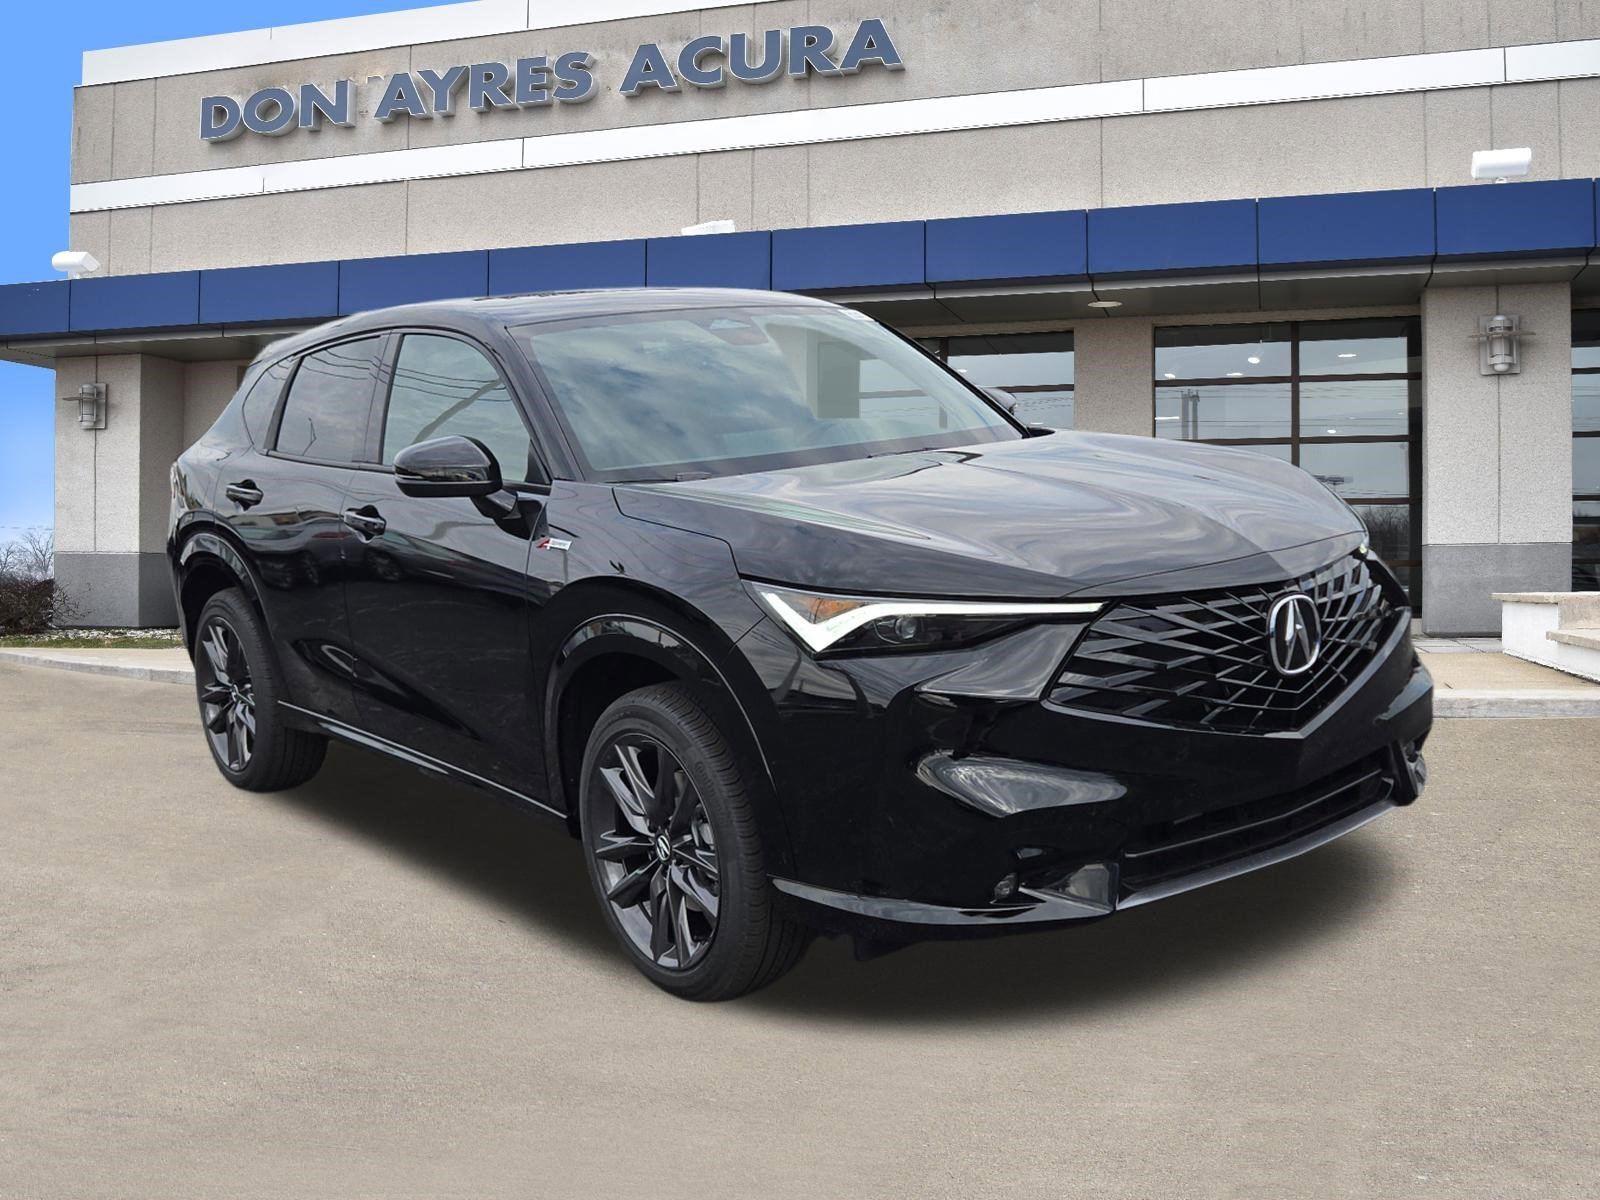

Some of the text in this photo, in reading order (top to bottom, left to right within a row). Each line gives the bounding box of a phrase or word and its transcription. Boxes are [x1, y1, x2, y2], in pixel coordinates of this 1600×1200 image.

[200, 17, 905, 142] DON AYRES ACURA
